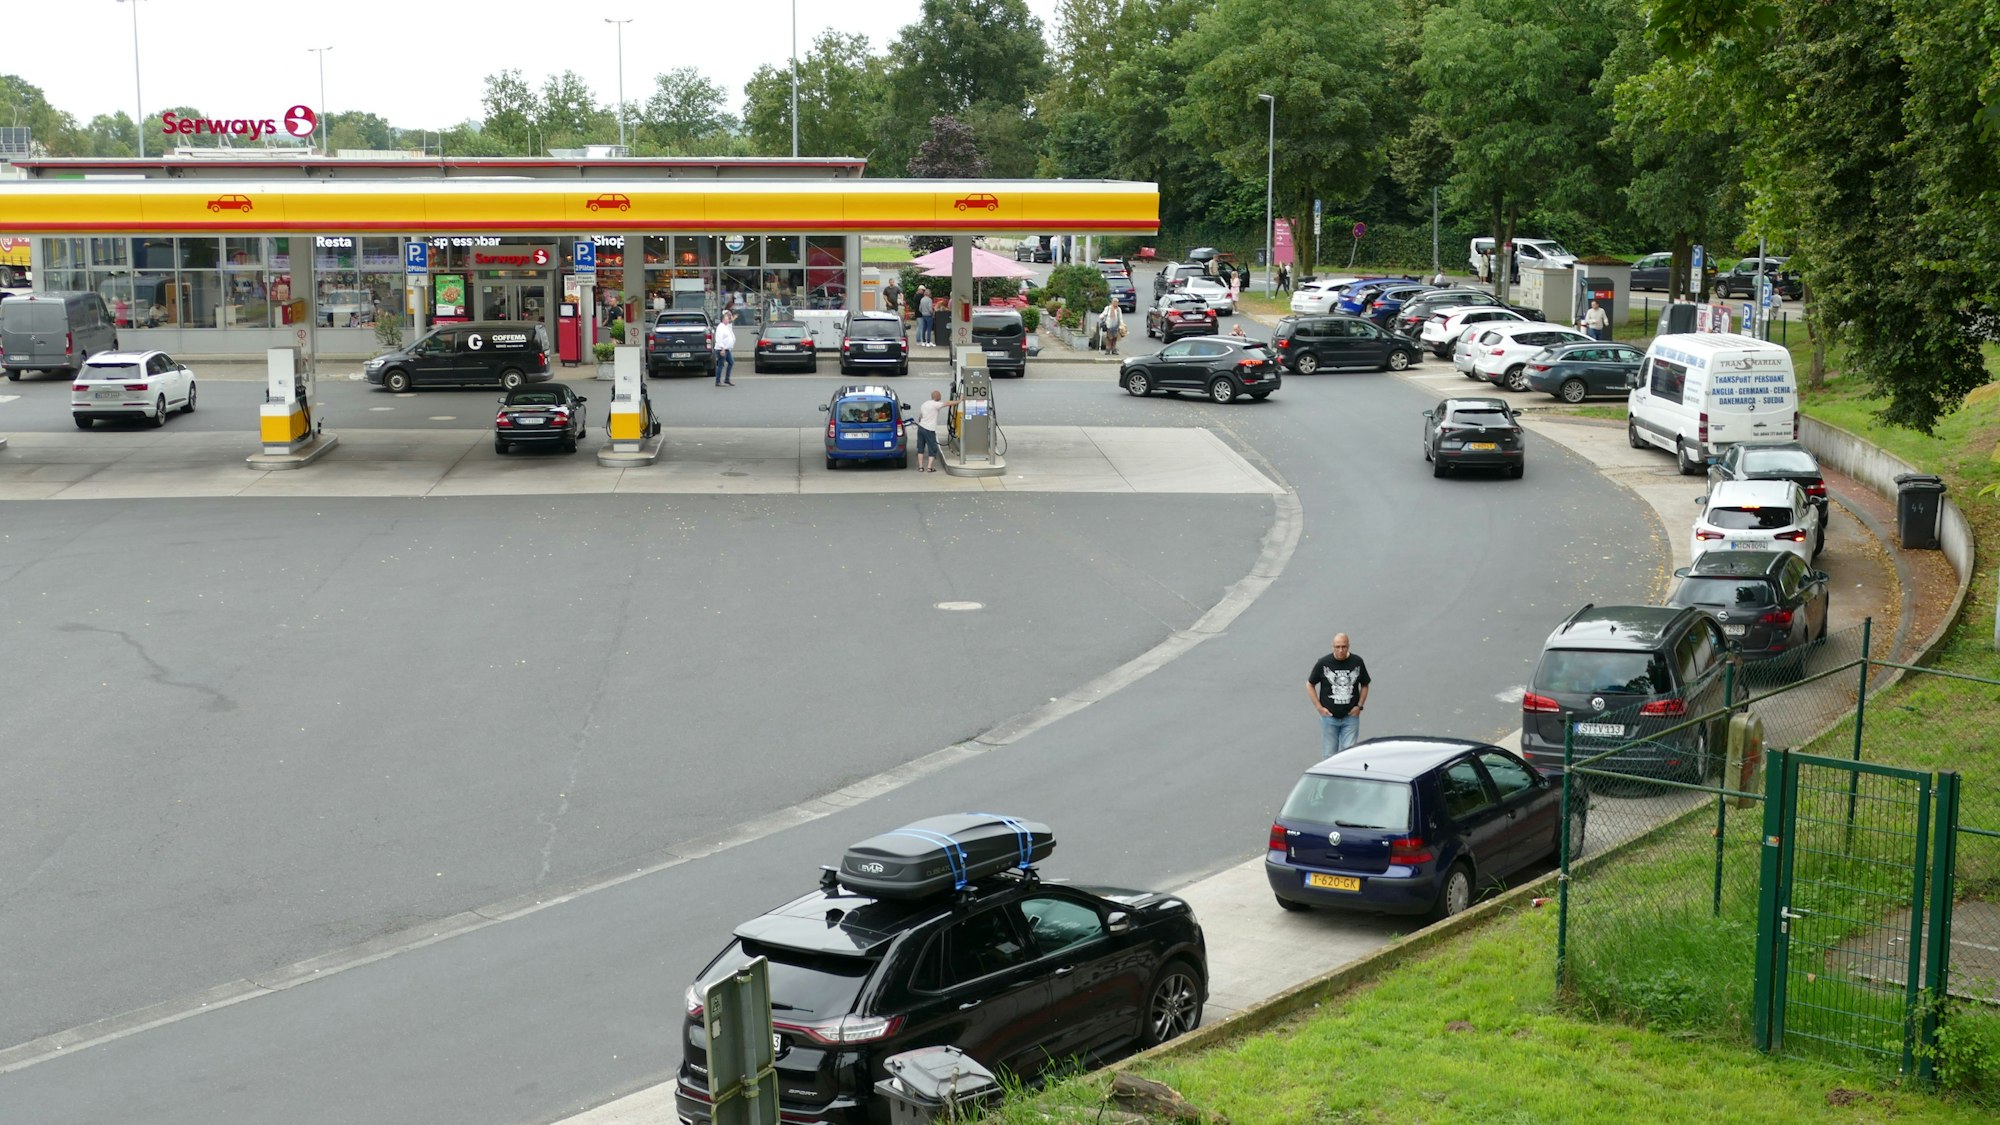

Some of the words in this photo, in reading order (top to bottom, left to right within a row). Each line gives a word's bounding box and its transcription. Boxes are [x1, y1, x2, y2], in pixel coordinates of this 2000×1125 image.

[162, 111, 276, 140] Serways
[409, 245, 421, 261] P
[577, 244, 589, 260] P
[475, 253, 530, 266] Serways
[966, 387, 987, 397] LPG
[1712, 388, 1734, 396] ANGLIA
[1738, 387, 1769, 395] GERMANIA
[1719, 397, 1756, 405] DANEMARCA
[1313, 873, 1357, 889] T-620-GK
[788, 1088, 818, 1097] SPORT
